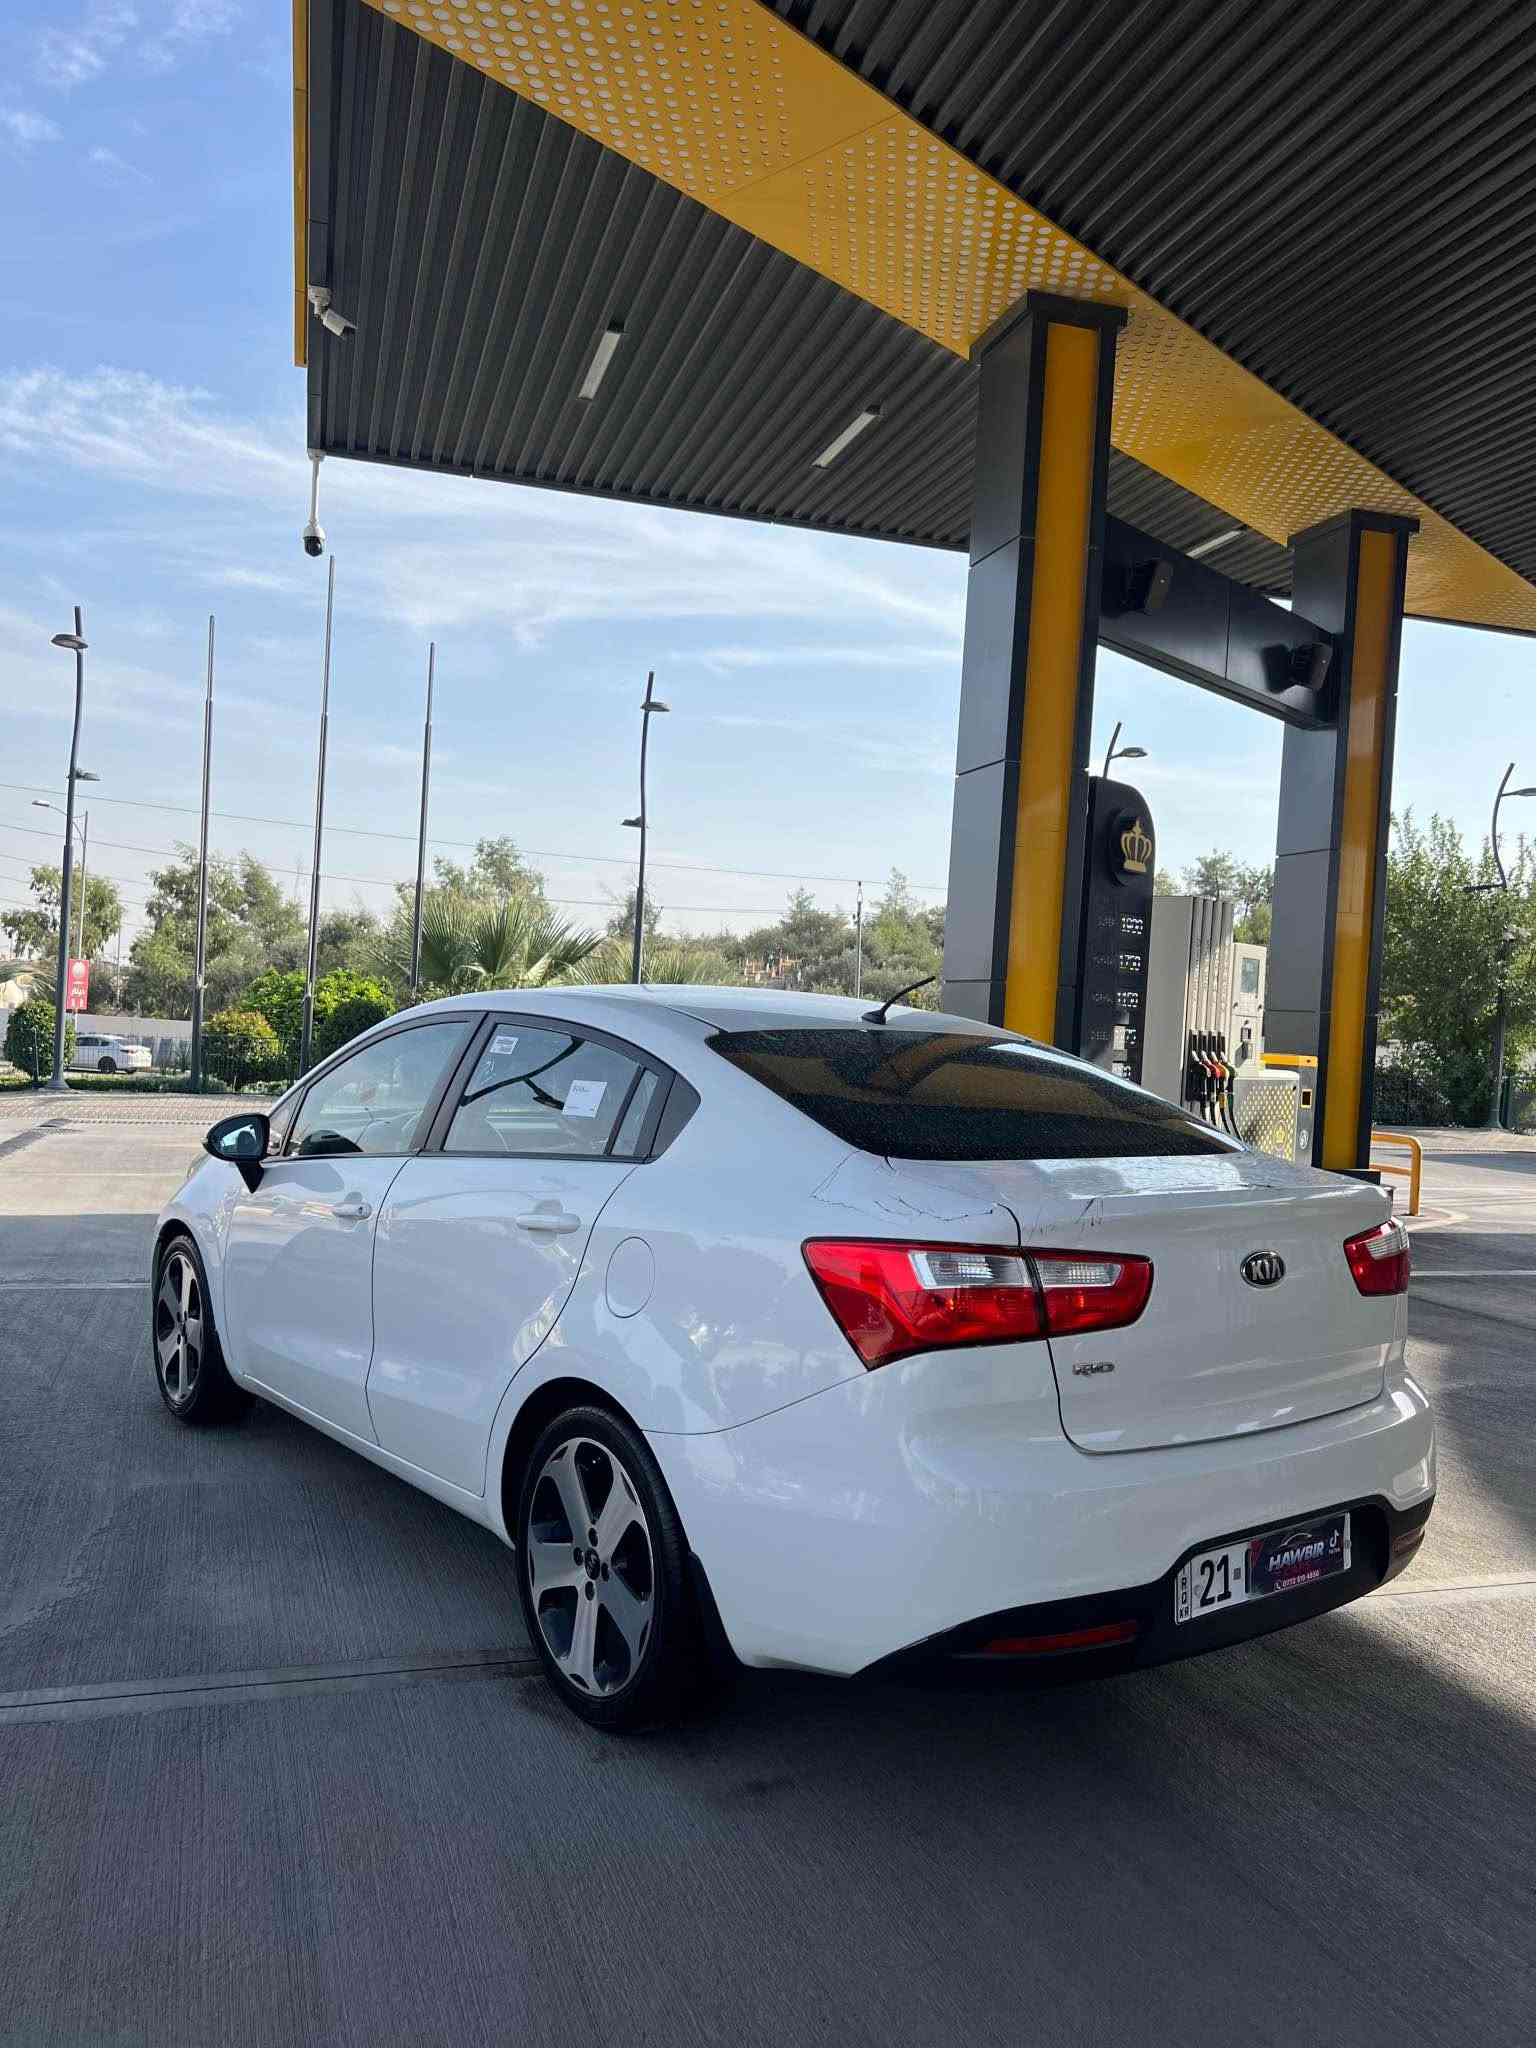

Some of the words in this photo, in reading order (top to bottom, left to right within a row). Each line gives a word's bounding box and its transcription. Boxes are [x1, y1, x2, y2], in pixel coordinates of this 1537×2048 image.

[1251, 1258, 1282, 1281] KIA
[1268, 1541, 1325, 1572] HAWBIR
[1200, 1554, 1232, 1607] 21
